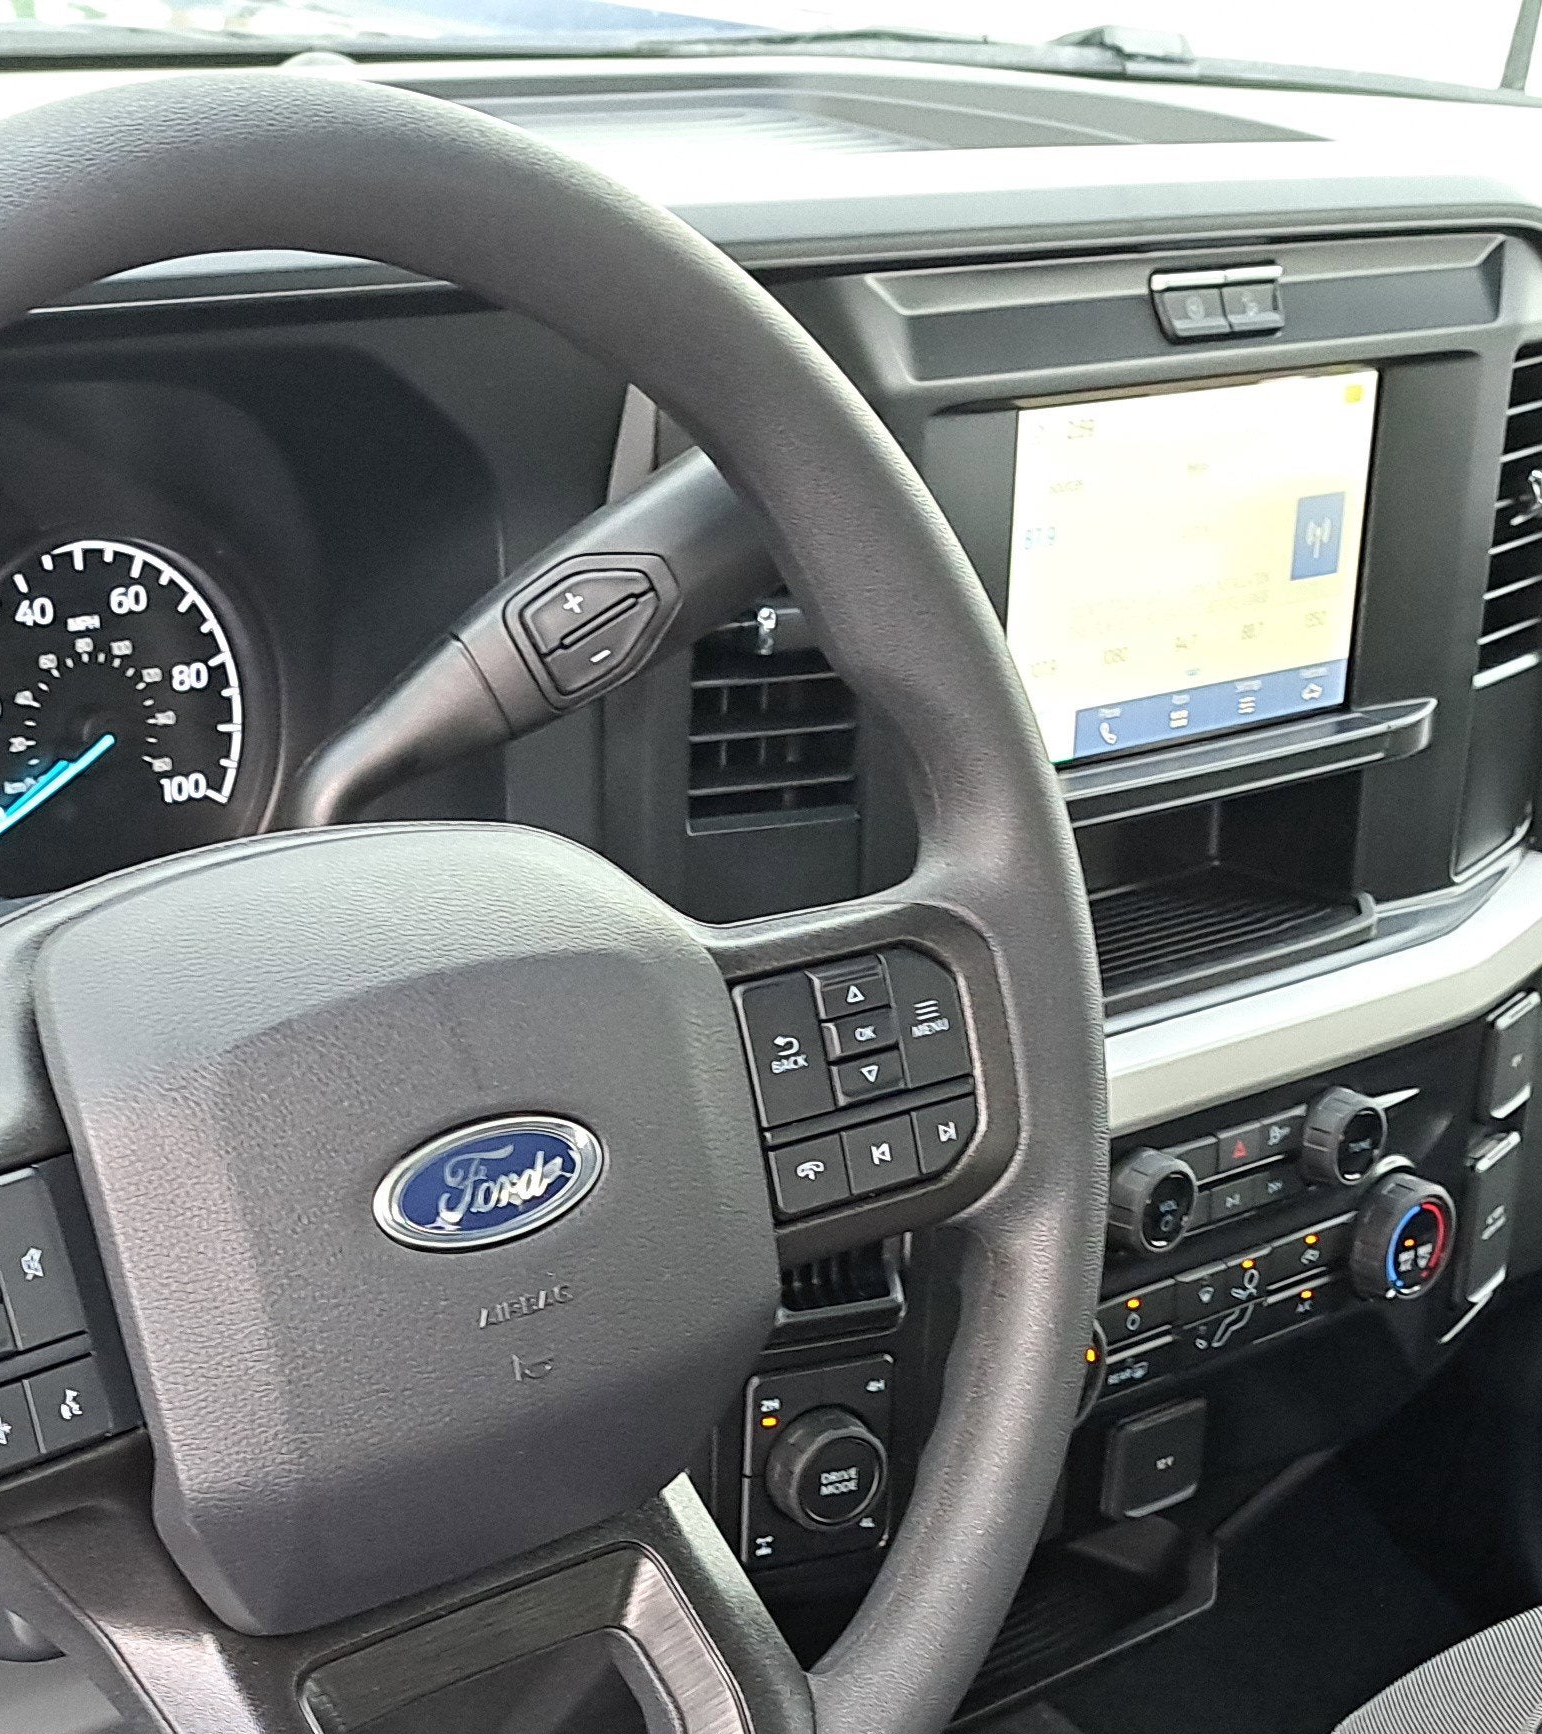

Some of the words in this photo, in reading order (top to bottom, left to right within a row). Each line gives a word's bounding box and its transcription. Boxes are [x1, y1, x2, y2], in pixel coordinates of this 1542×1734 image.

[15, 597, 54, 626] 40
[110, 585, 147, 614] 60
[172, 662, 208, 691] 80
[160, 773, 207, 803] 100
[855, 1026, 877, 1042] OK
[912, 1017, 950, 1038] MENU
[771, 1054, 809, 1074] BACK
[429, 1143, 569, 1231] Ford
[820, 1466, 858, 1485] DRIVE
[820, 1479, 858, 1496] MODE
